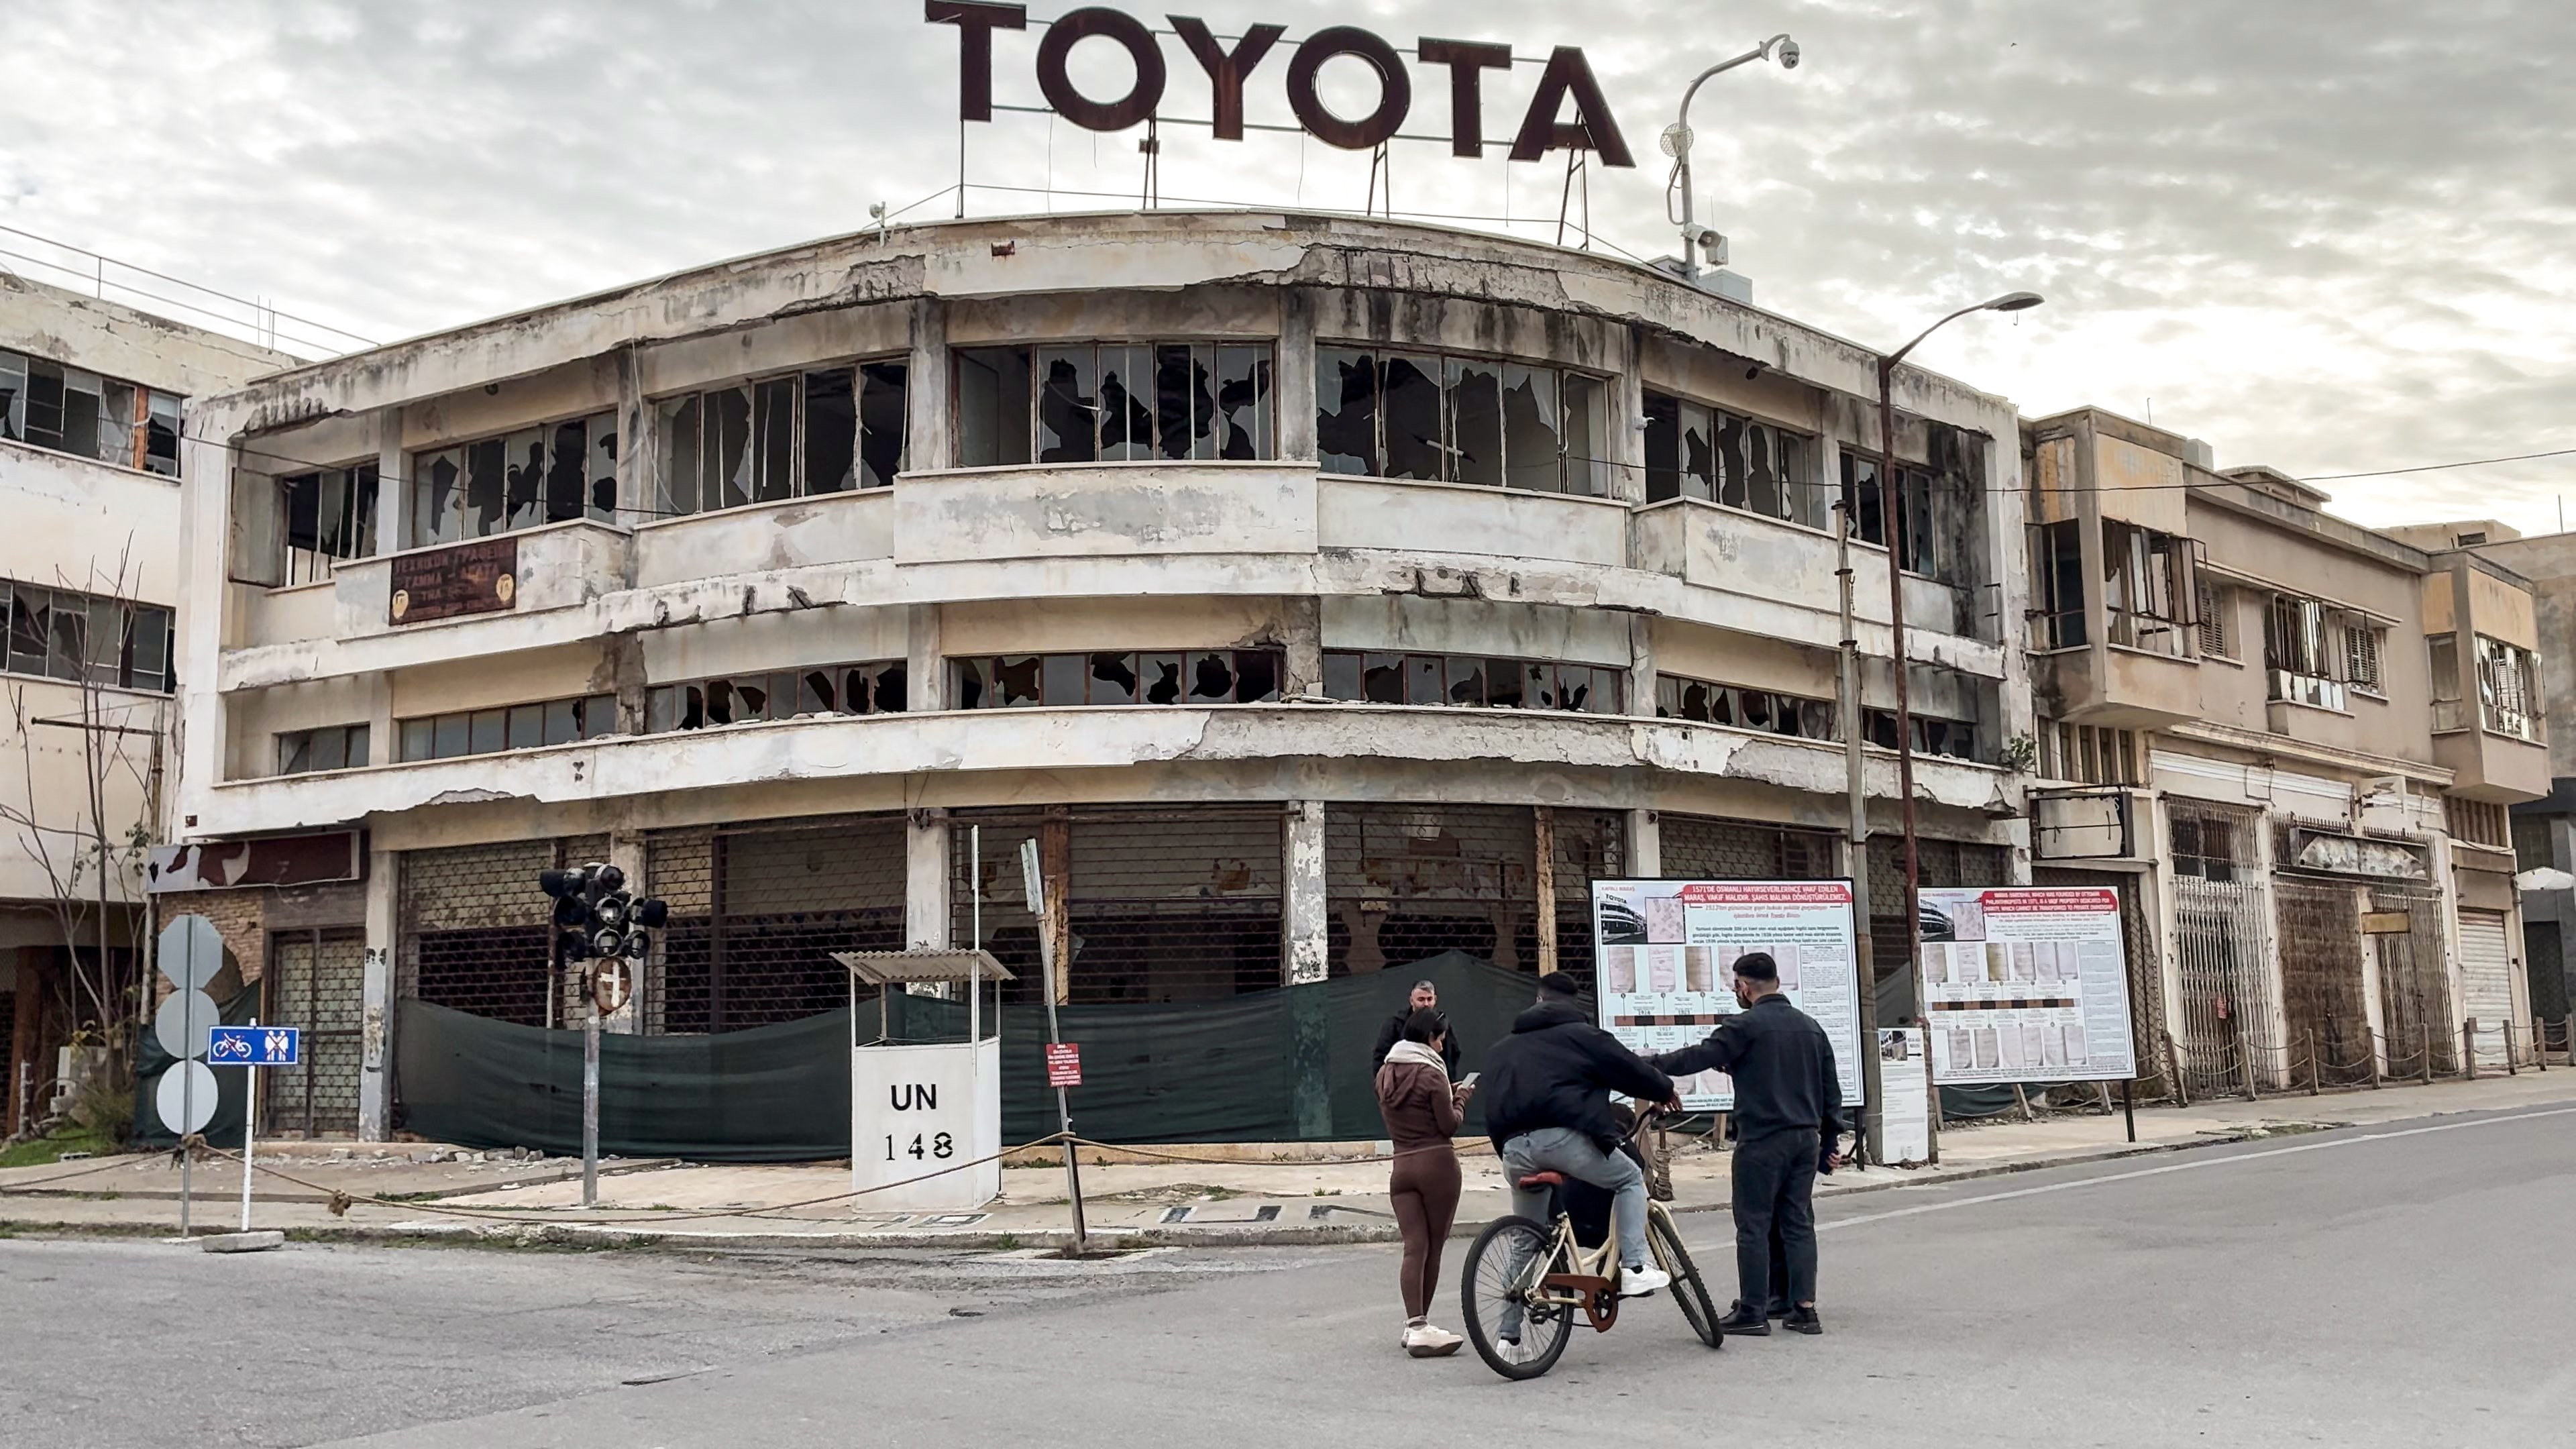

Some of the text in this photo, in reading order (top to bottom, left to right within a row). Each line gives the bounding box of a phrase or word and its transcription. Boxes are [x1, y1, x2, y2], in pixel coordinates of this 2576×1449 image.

[925, 0, 1636, 168] TOYOTA
[891, 1083, 936, 1112] UN
[885, 1132, 954, 1161] 148
